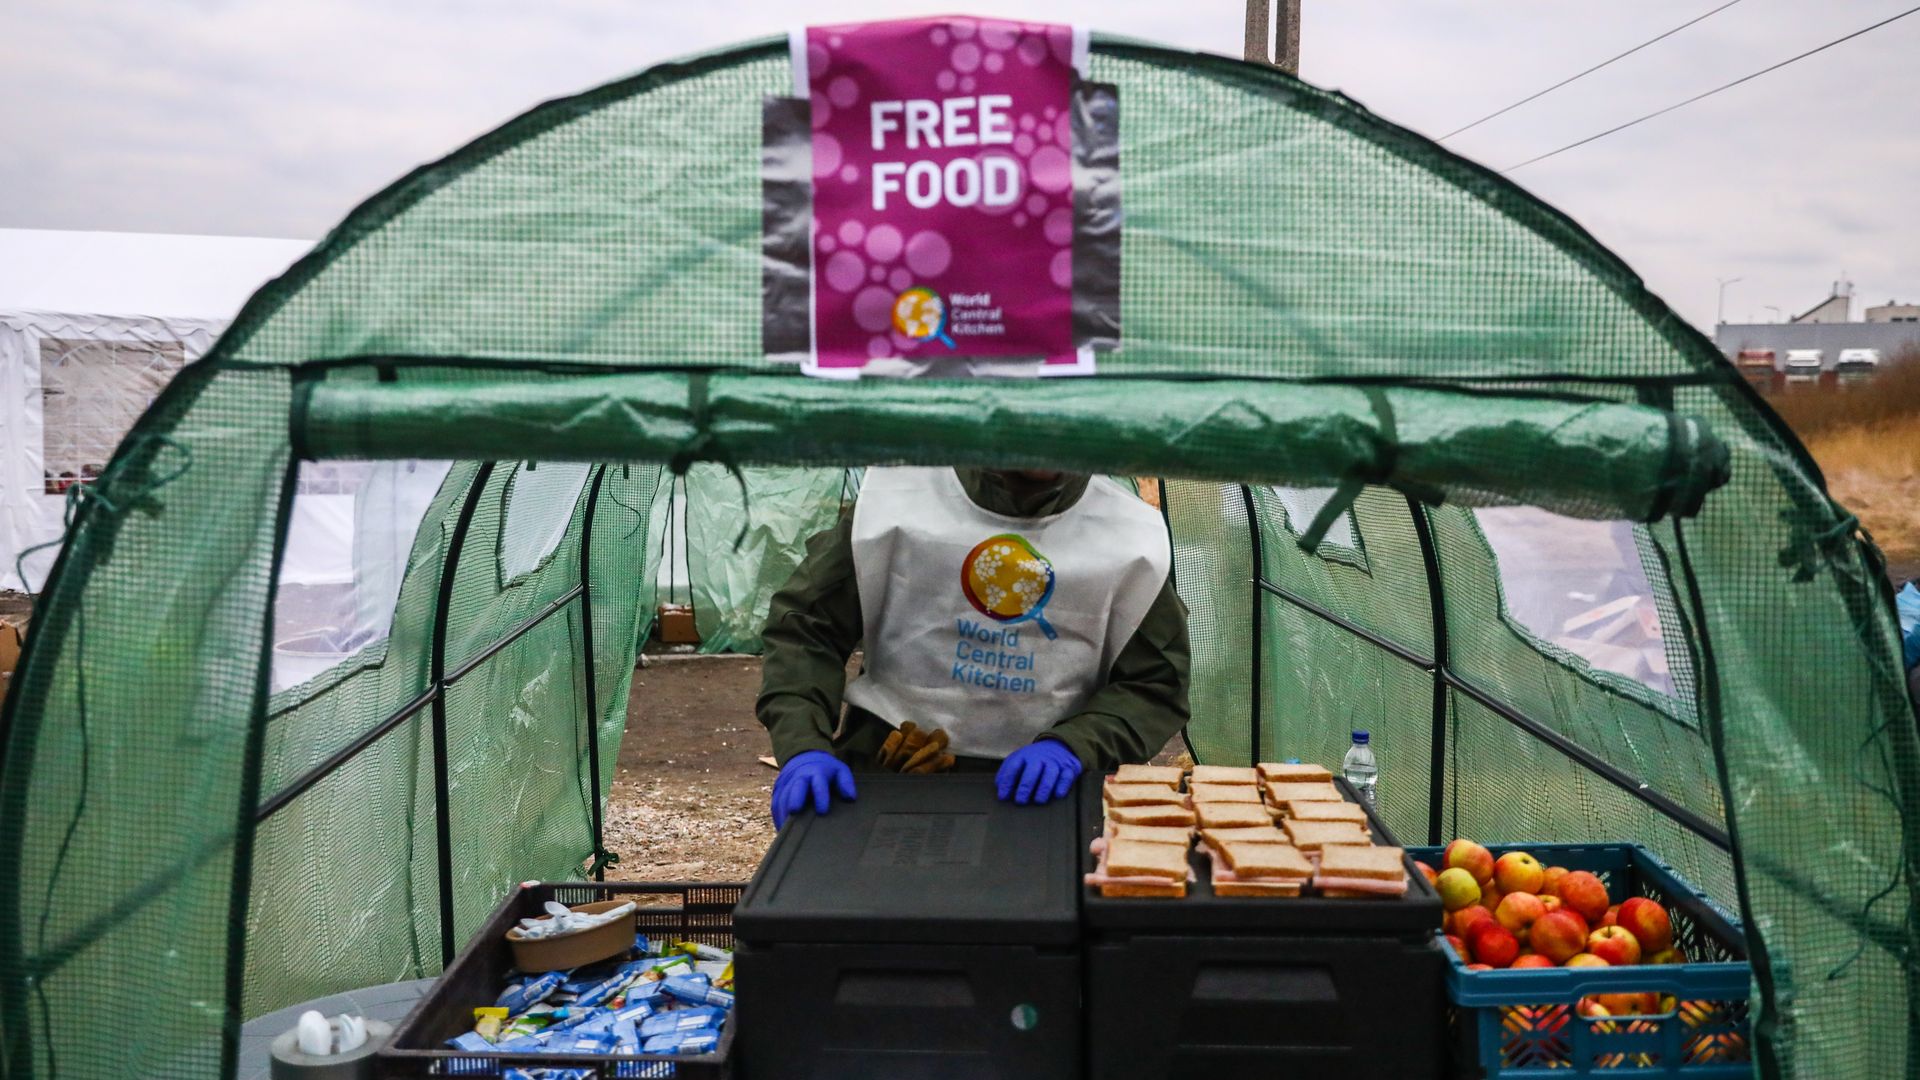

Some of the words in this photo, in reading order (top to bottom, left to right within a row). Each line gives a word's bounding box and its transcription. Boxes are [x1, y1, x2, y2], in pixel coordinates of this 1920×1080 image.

[870, 95, 1013, 149] FREE
[871, 157, 1020, 211] FOOD
[949, 293, 991, 306] World
[951, 307, 1002, 321] Central
[951, 323, 1005, 335] Kitchen
[957, 619, 1019, 646] World
[956, 641, 1034, 670] Central
[952, 663, 1036, 692] Kitchen
